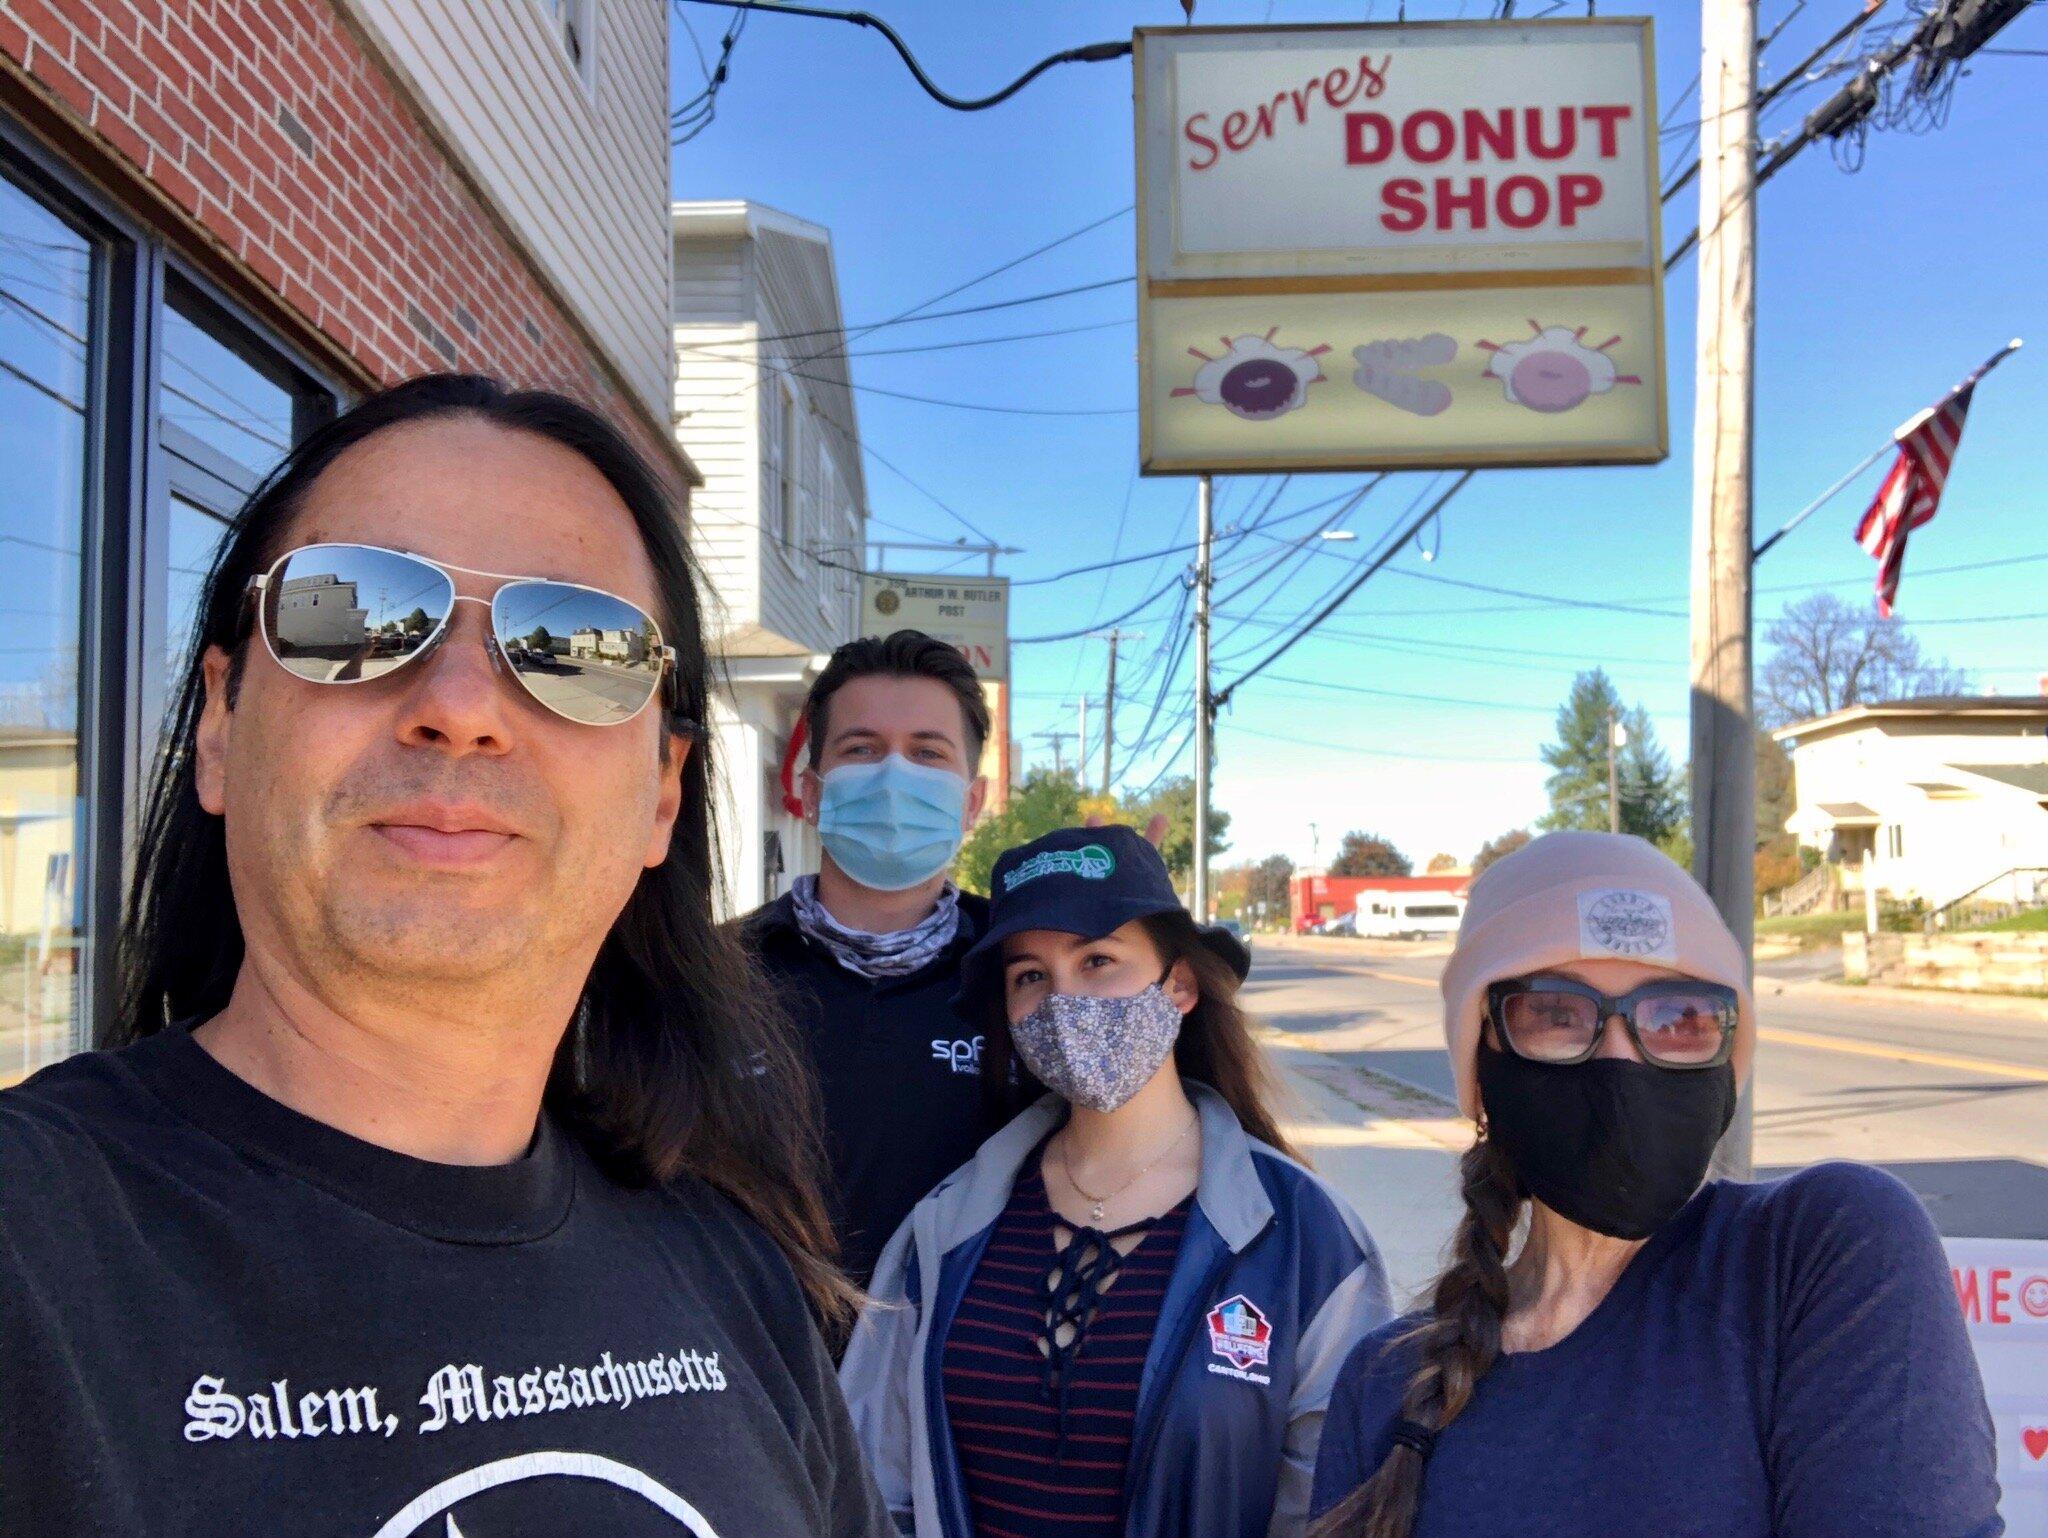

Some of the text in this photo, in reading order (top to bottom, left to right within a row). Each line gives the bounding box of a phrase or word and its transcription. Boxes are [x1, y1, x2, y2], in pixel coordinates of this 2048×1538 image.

[1184, 54, 1392, 171] Serres
[1345, 105, 1632, 166] DONUT
[1380, 174, 1604, 232] SHOP
[938, 605, 965, 617] POST
[963, 589, 1001, 601] BUTLER
[183, 1348, 728, 1442] Salem, Massachusetts
